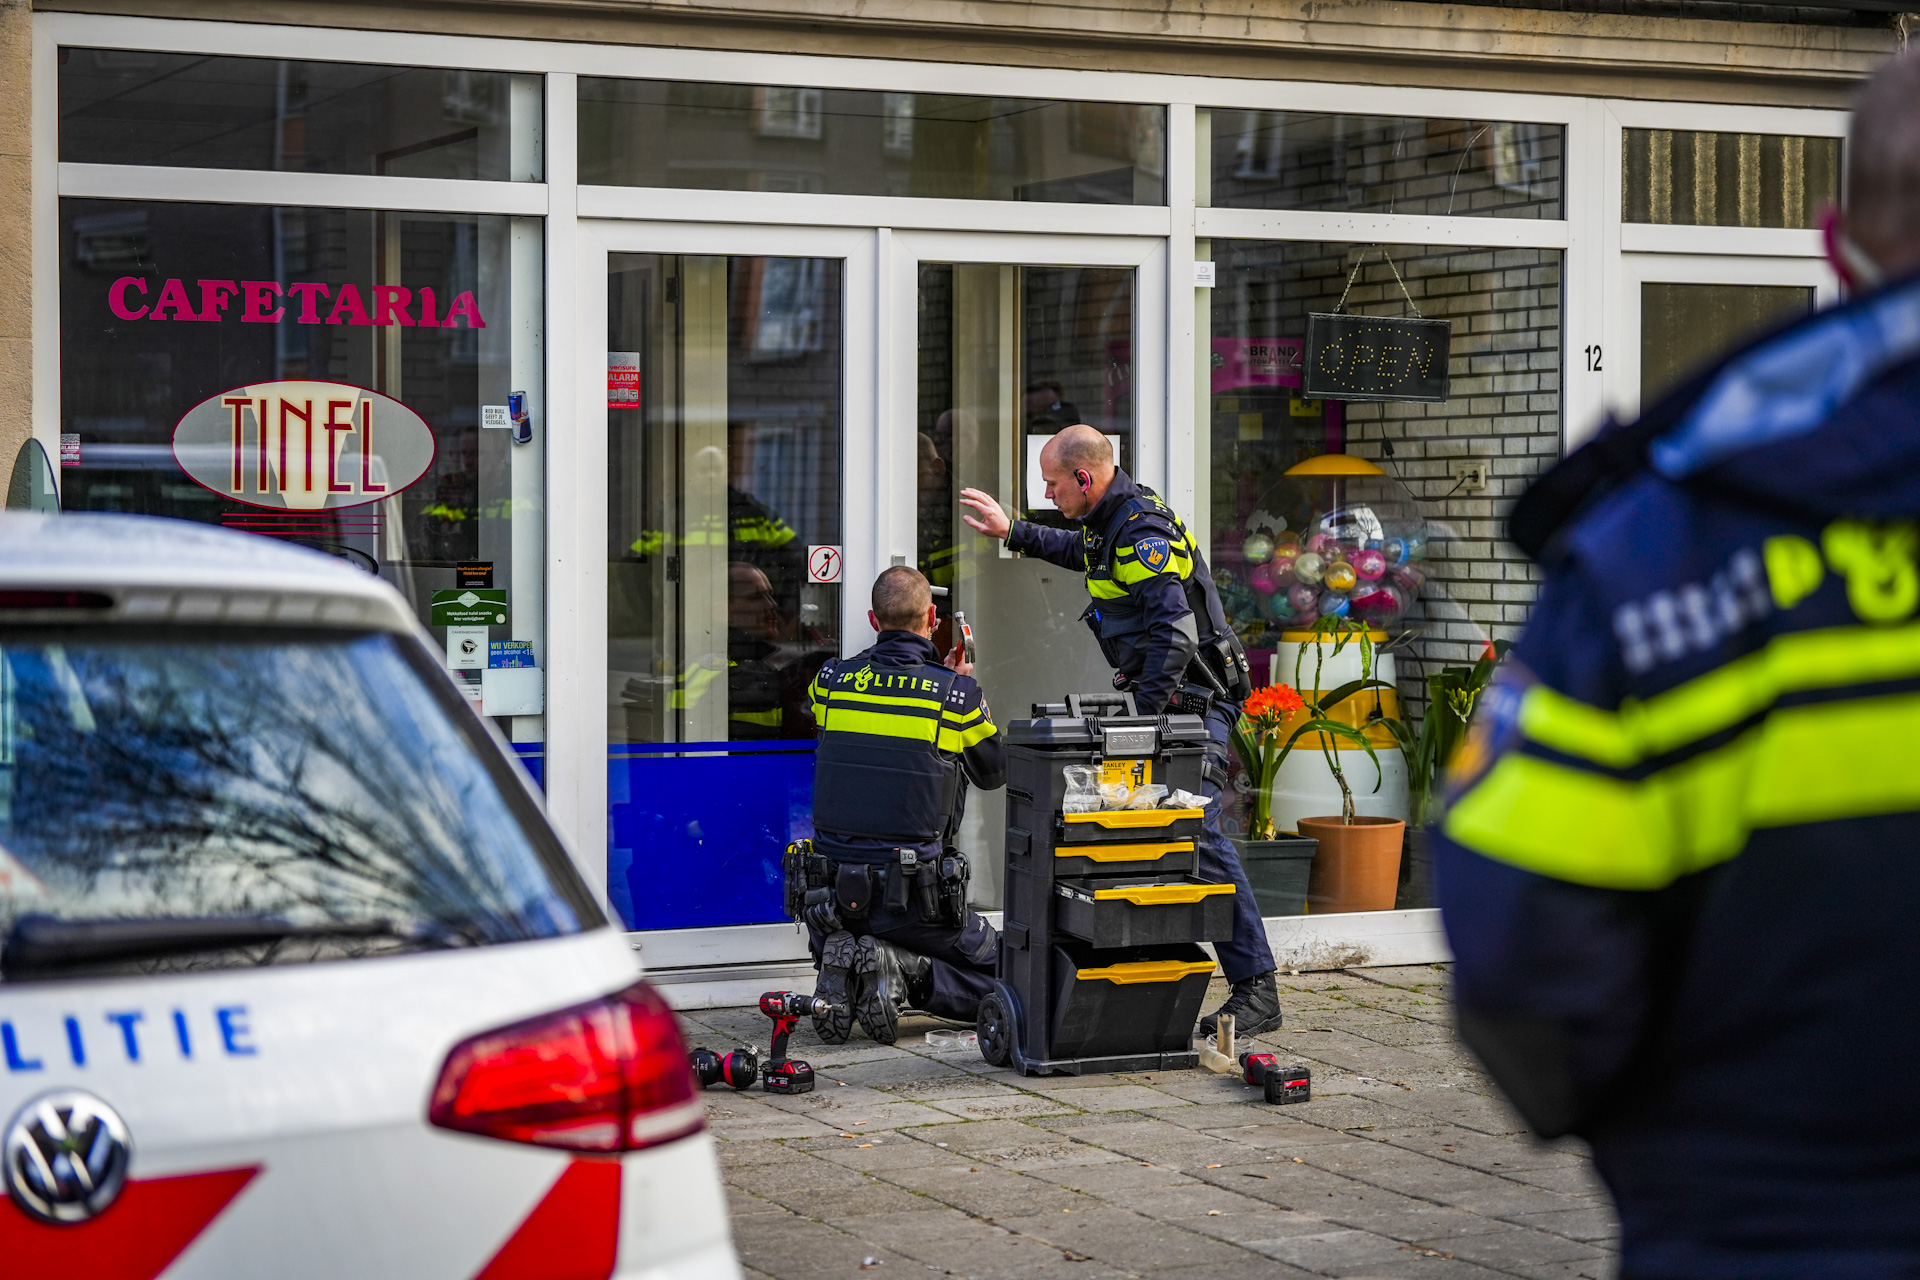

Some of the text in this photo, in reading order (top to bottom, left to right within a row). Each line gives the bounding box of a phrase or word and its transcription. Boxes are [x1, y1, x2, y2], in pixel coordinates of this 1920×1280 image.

[108, 276, 487, 328] CAFETARIA
[1250, 346, 1297, 359] BRAND
[1320, 343, 1434, 379] OPEN
[1585, 344, 1602, 371] 12
[221, 396, 388, 495] TINEL
[1139, 540, 1164, 550] POLITIE
[842, 666, 933, 692] POLITIE
